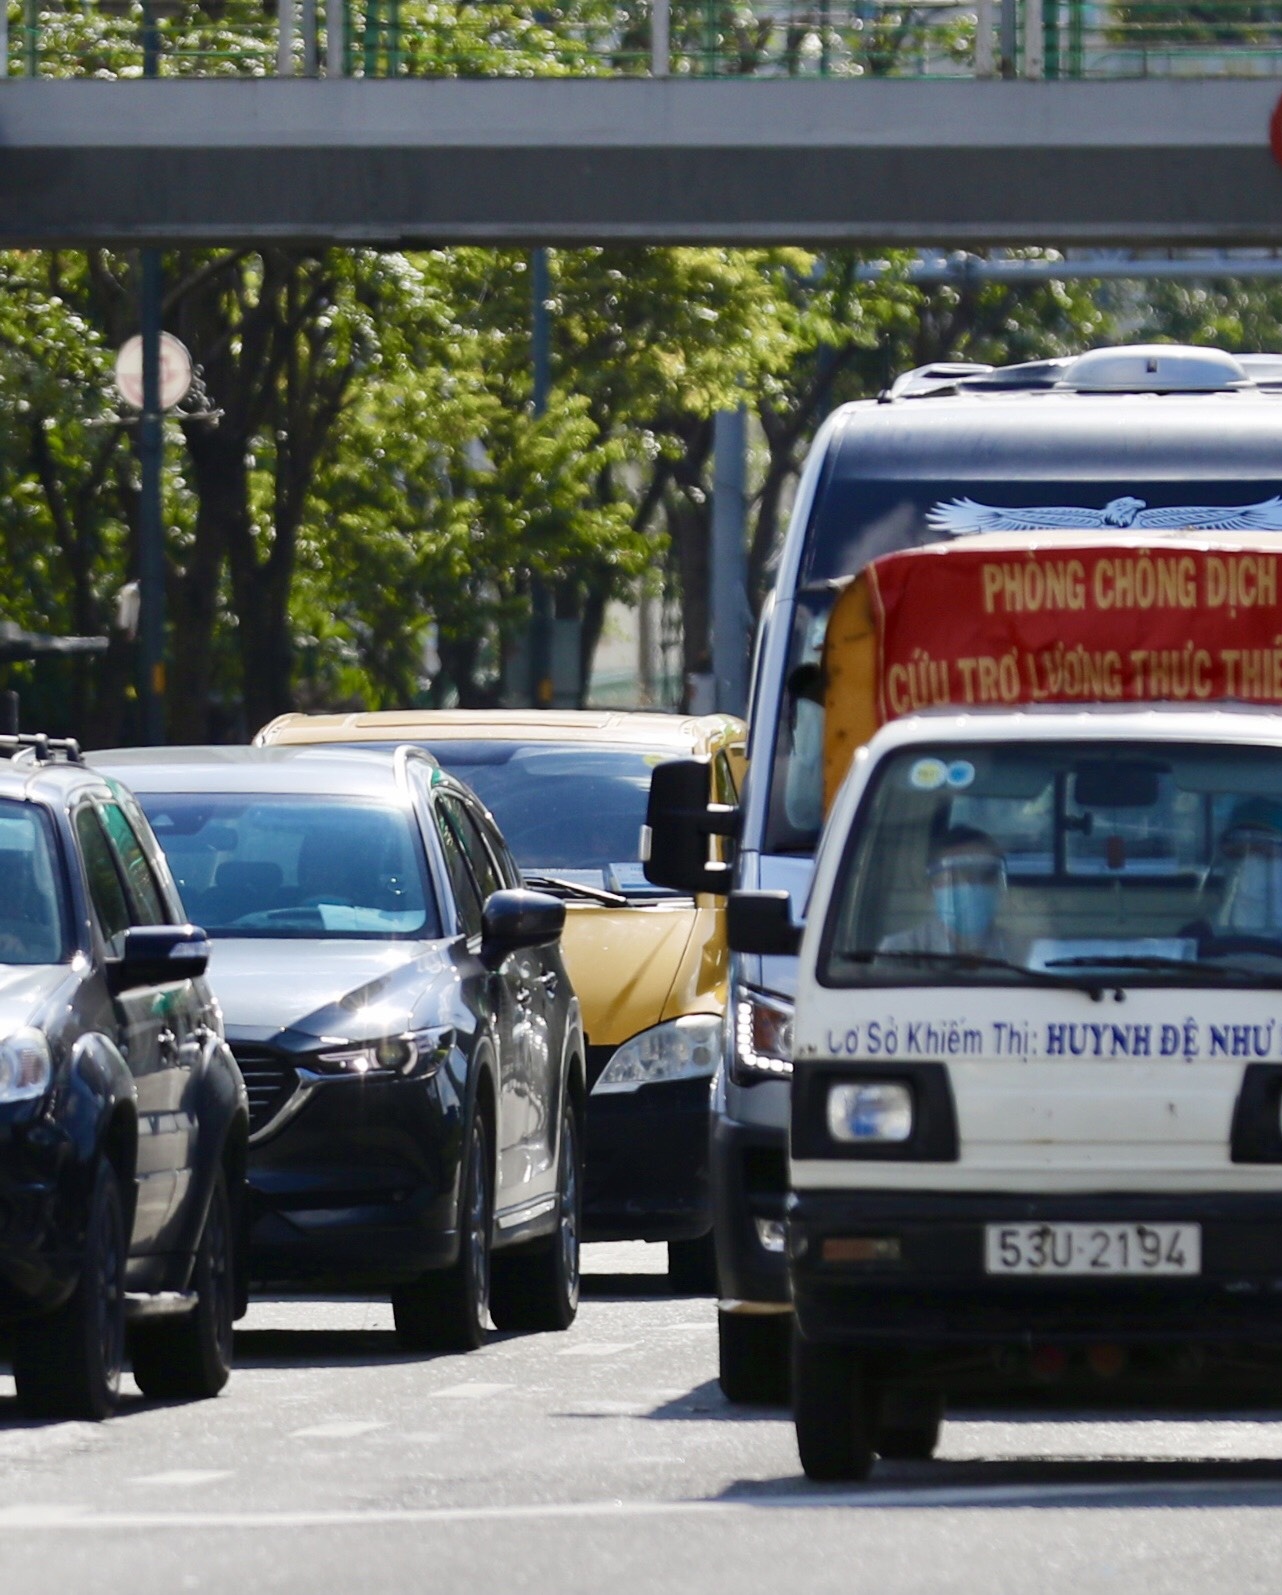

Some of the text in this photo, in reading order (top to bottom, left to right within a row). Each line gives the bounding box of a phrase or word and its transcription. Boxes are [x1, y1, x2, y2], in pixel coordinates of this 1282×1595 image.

[1206, 556, 1277, 619] DỊCH
[867, 1016, 899, 1055] Sở
[1047, 1023, 1152, 1056] HUYNH
[1159, 1017, 1200, 1063] ĐỆ
[1210, 1018, 1276, 1058] NHƯ
